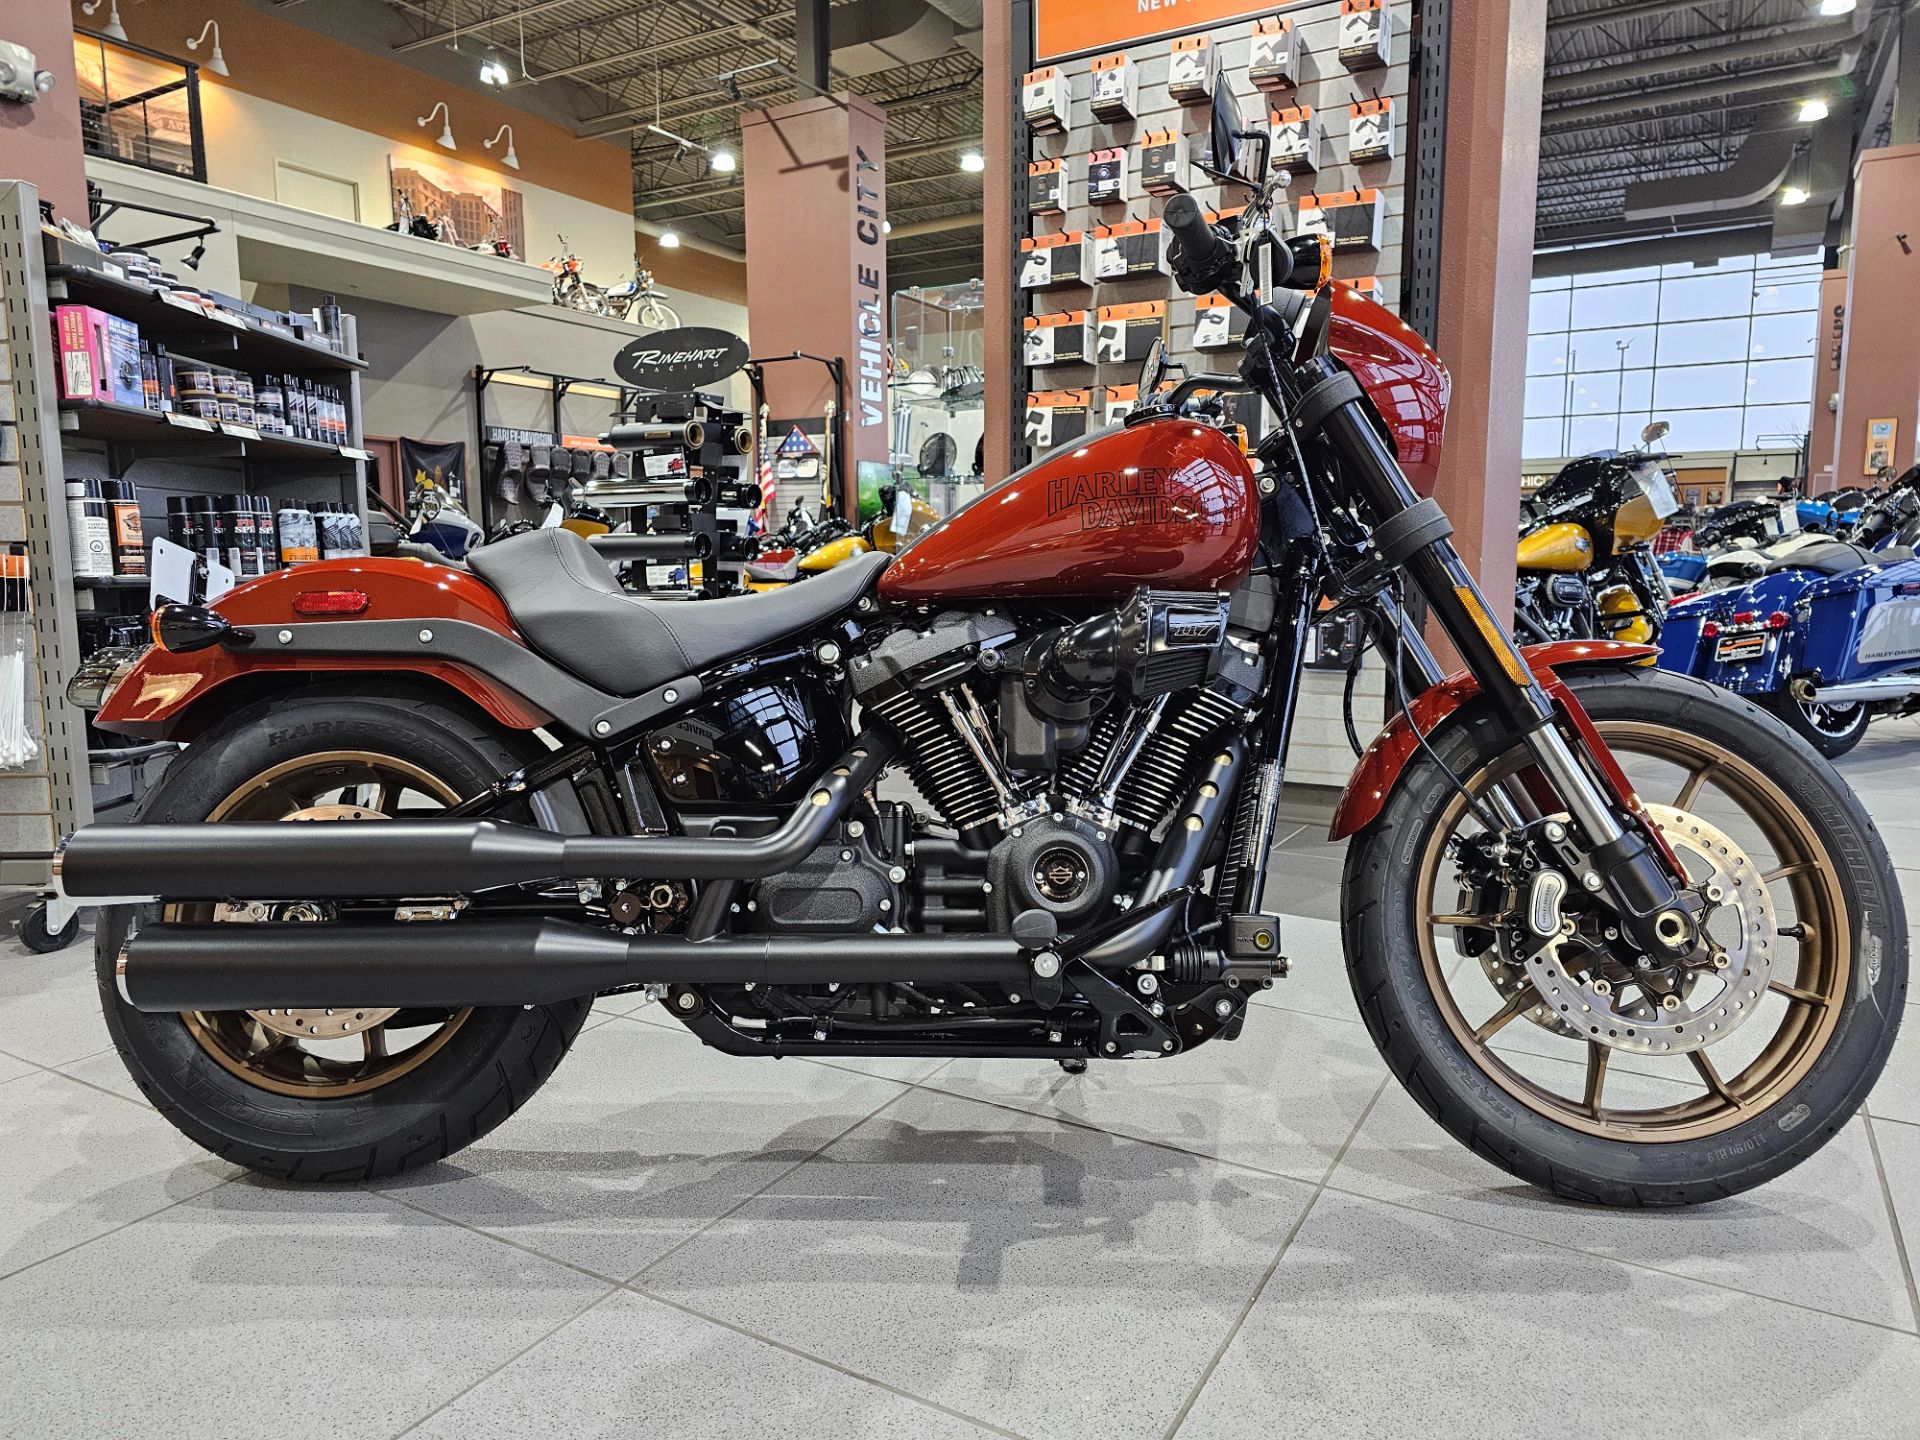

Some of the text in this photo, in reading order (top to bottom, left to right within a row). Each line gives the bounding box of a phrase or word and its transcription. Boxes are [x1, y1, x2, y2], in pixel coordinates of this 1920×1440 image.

[856, 145, 882, 427] VEHICLE CITY
[632, 347, 728, 369] RINEHART
[641, 361, 719, 374] RACING
[493, 428, 553, 445] HARLEY-DAVIDSON
[1048, 467, 1180, 517] HARLEY
[1174, 624, 1217, 637] 117
